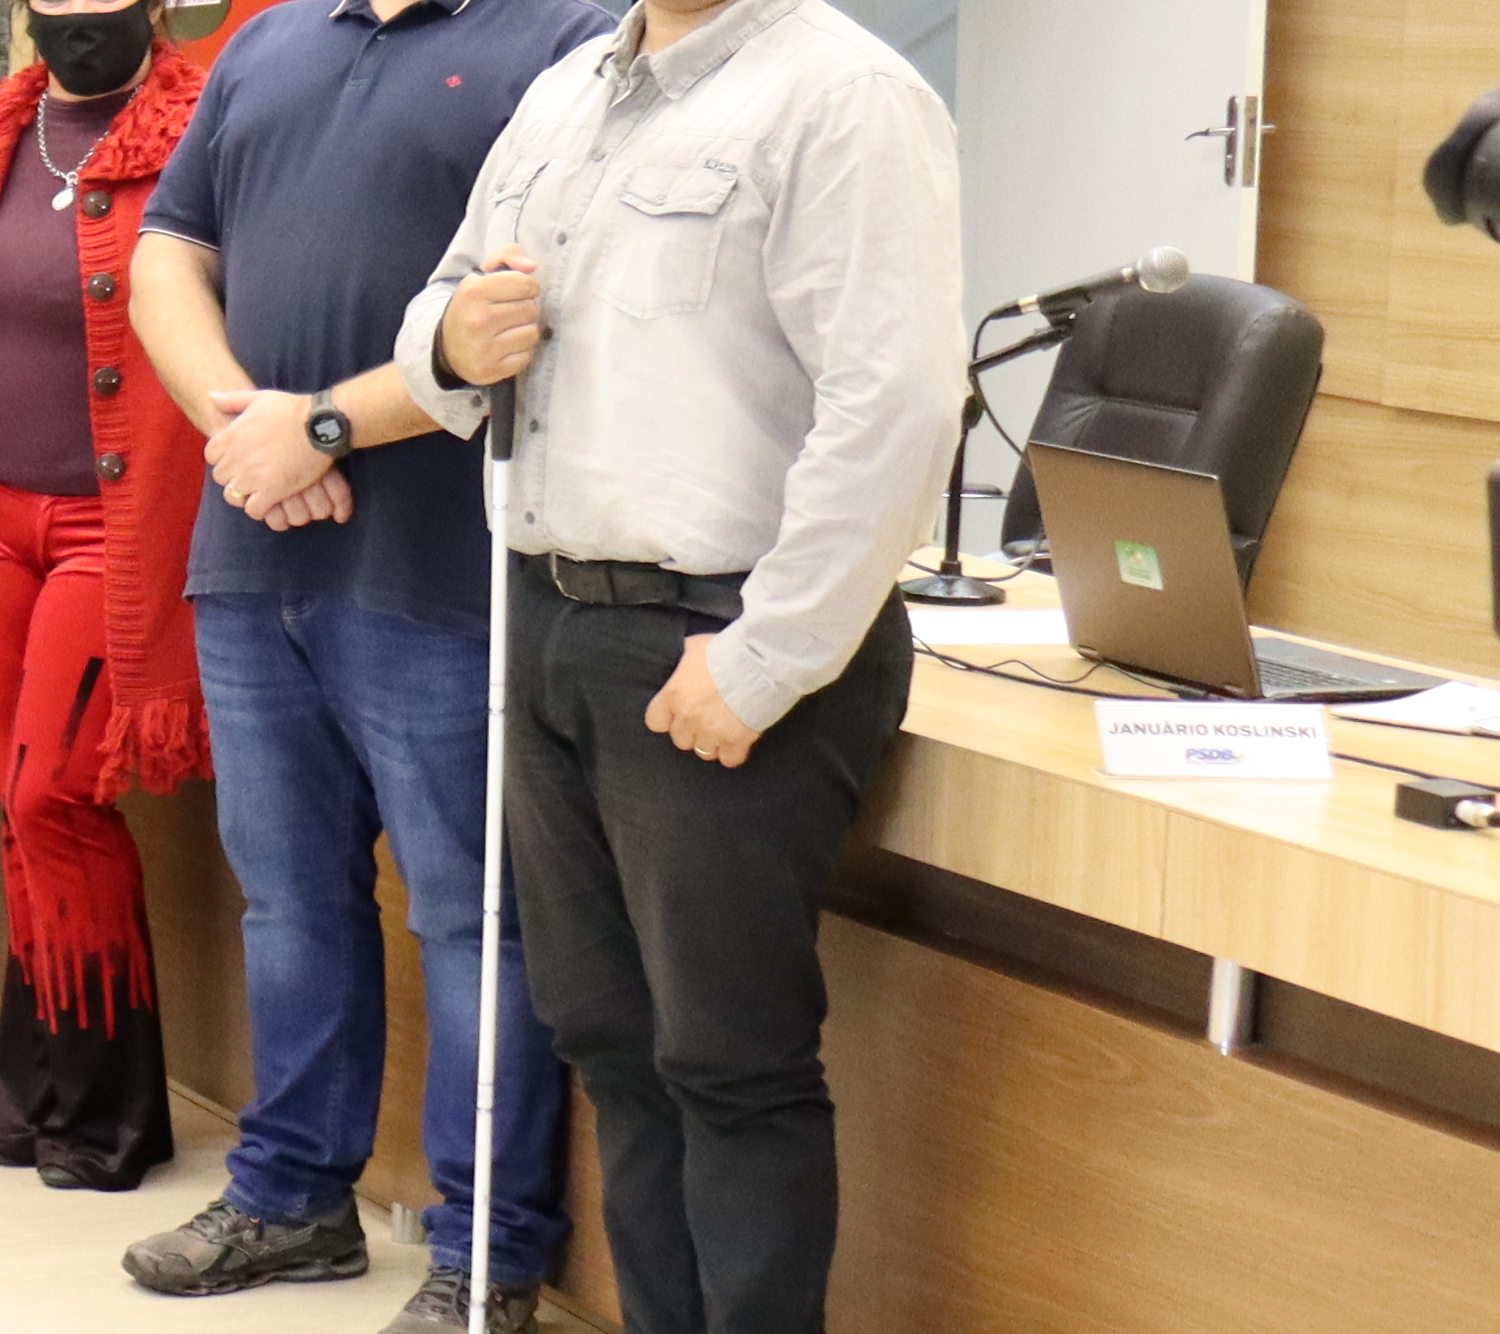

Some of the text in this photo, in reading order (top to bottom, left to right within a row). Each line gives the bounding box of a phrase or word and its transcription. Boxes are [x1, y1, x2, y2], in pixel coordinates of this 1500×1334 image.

[1108, 721, 1318, 739] JANUÁRIO KOSLINSKI
[1185, 748, 1236, 762] PSDB
